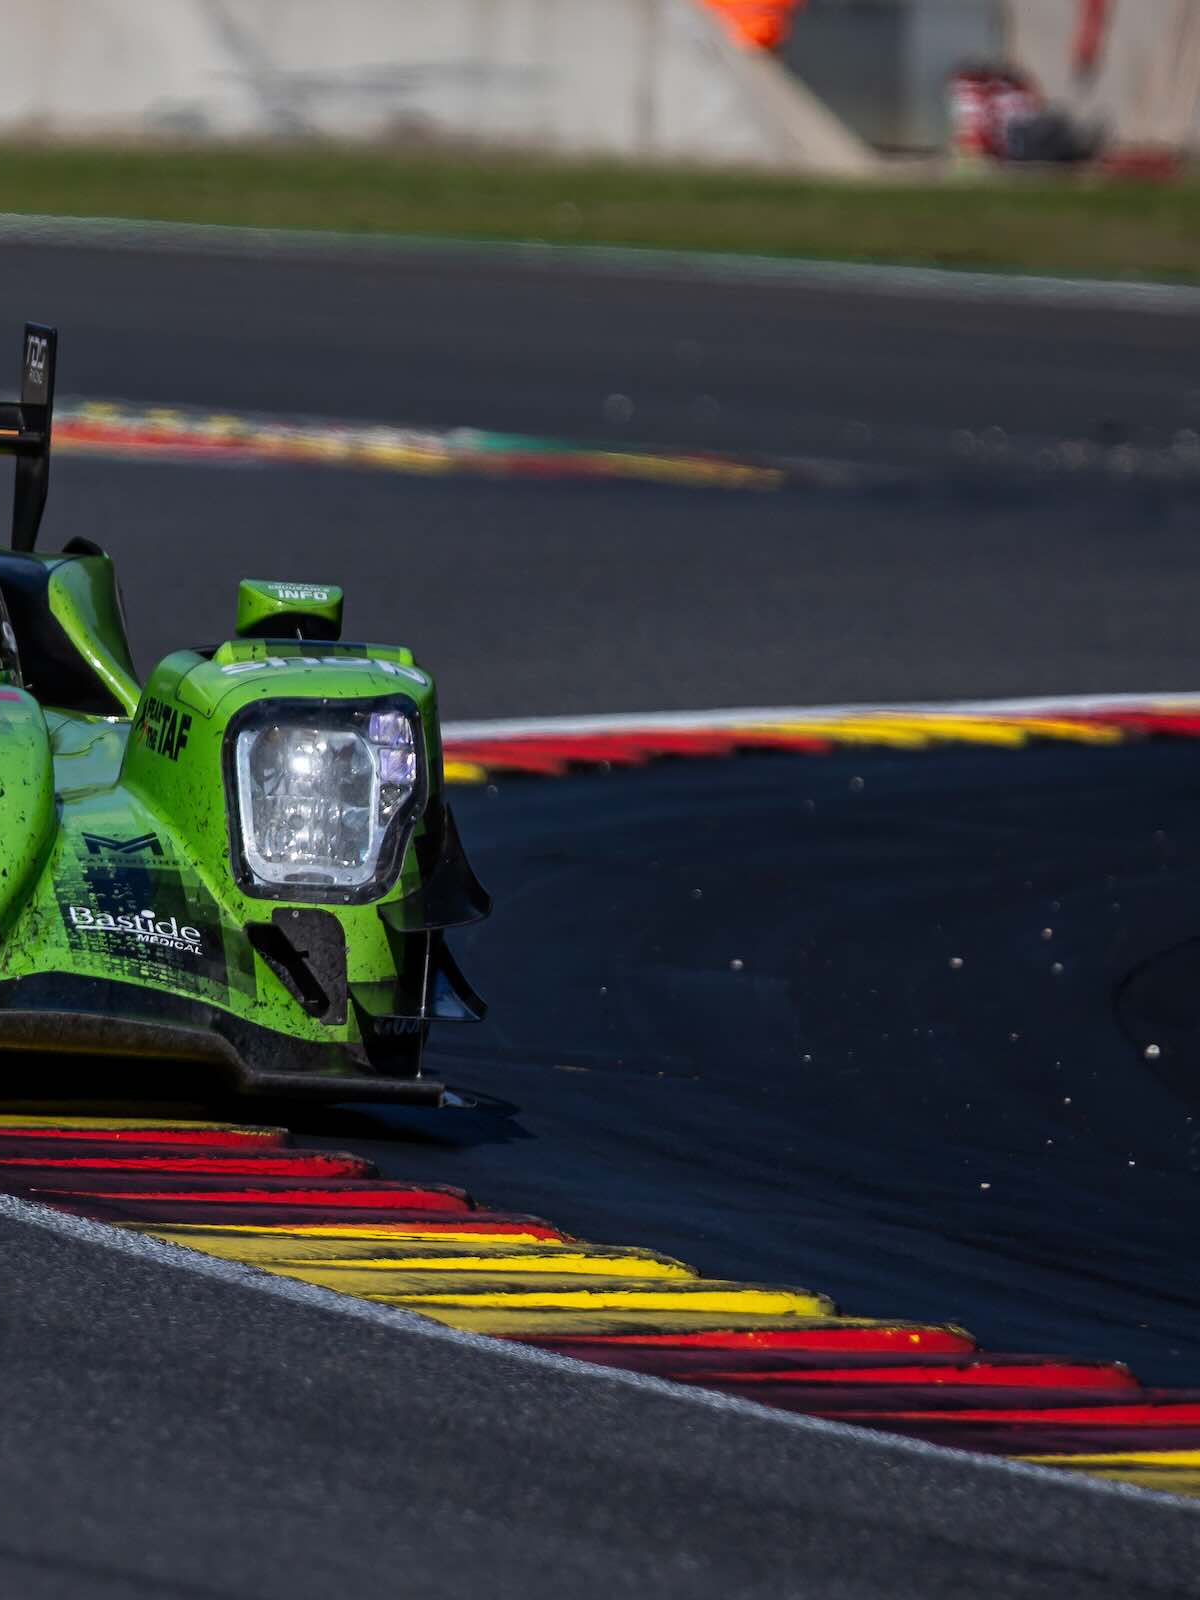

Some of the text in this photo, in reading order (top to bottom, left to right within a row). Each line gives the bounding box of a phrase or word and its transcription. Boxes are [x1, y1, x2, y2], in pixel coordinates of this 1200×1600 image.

[279, 590, 328, 601] INFO
[69, 904, 201, 943] Bastide
[136, 933, 204, 956] MEDICAL
